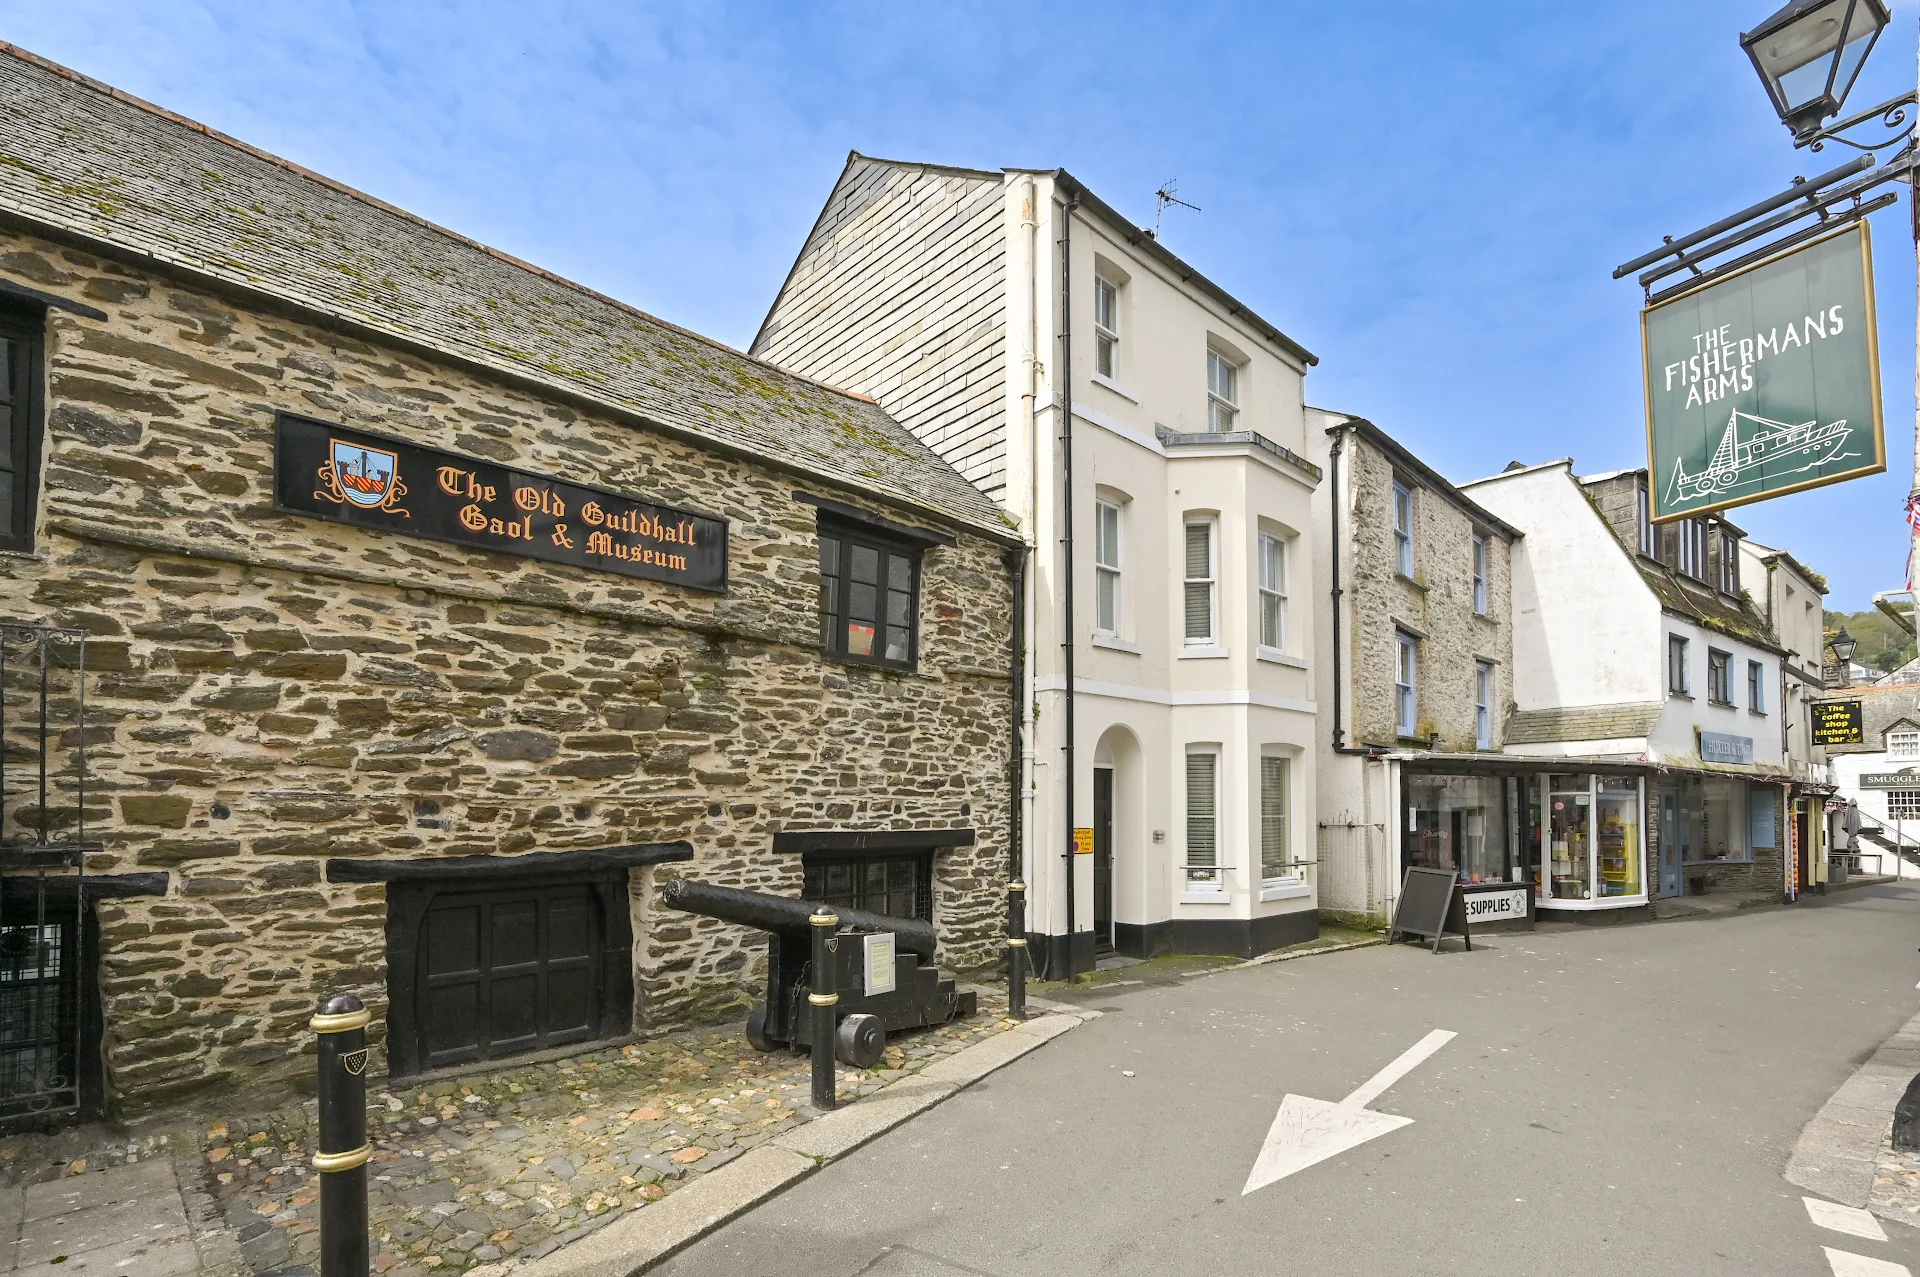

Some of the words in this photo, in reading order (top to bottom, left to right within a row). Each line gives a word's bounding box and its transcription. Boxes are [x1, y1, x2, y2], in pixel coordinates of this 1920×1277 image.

[1664, 304, 1845, 392] FISHERMANS
[1692, 323, 1731, 354] THE
[1685, 364, 1753, 410] ARMS
[435, 466, 497, 503] The
[513, 486, 566, 517] Old
[581, 501, 696, 547] Guildhall
[459, 503, 534, 541] Gaol
[551, 523, 574, 549] &
[585, 530, 687, 571] Museum
[1821, 713, 1851, 721] coffee
[1867, 775, 1920, 784] SMUGGLE
[1470, 898, 1511, 915] SUPPLIES
